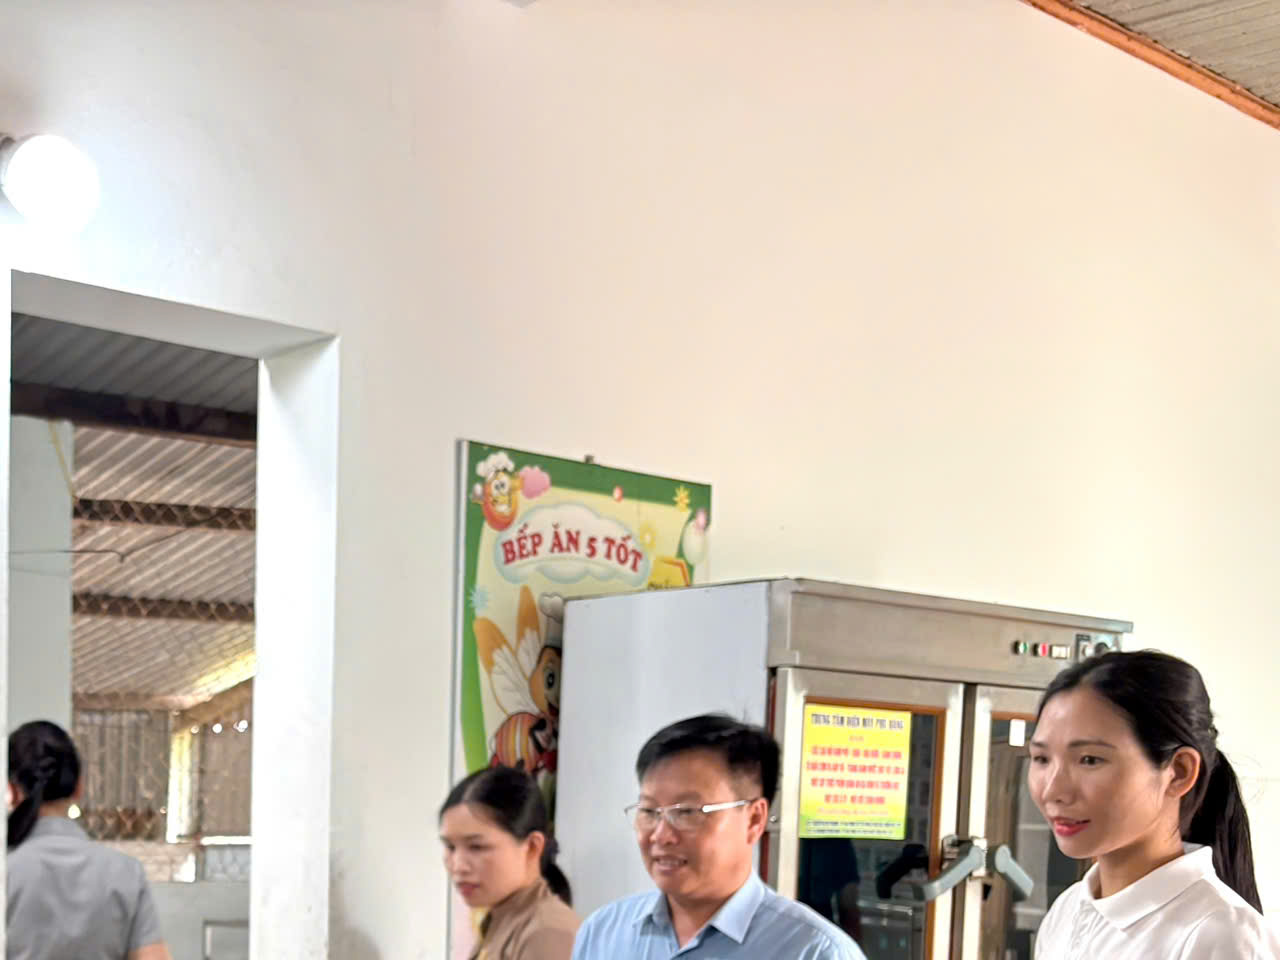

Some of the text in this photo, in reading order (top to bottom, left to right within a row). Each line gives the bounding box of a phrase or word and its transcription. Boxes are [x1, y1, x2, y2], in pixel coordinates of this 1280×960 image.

[501, 522, 643, 573] BẾP ĂN 5 TỐT
